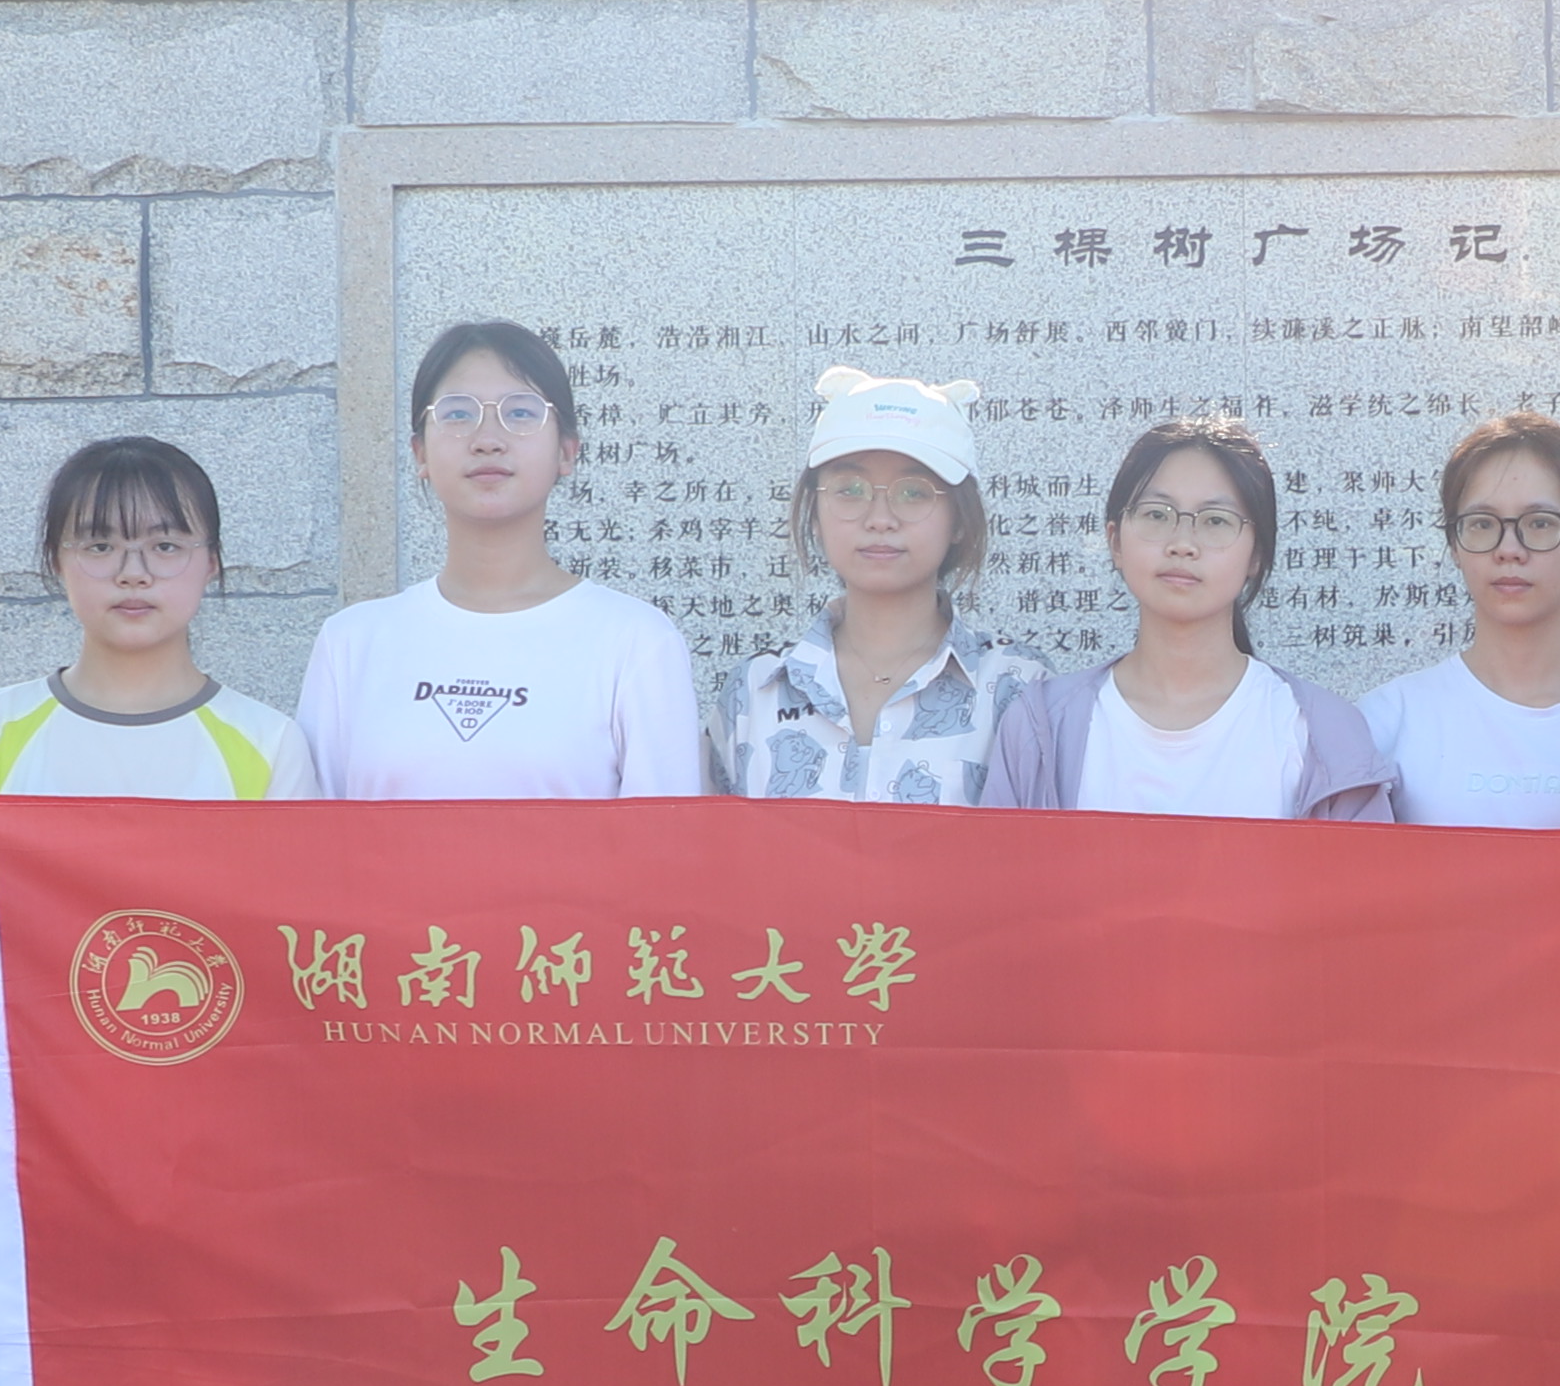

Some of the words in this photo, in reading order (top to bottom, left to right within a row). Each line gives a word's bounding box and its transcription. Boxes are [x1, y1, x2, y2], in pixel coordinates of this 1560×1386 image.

[952, 221, 1508, 269] 三棵树广场记
[86, 988, 118, 1034] Hunan
[120, 1029, 180, 1052] Normal
[183, 982, 234, 1043] University
[141, 1012, 182, 1026] 1938
[325, 1021, 458, 1045] HUNAN
[471, 1023, 634, 1046] NORMAL
